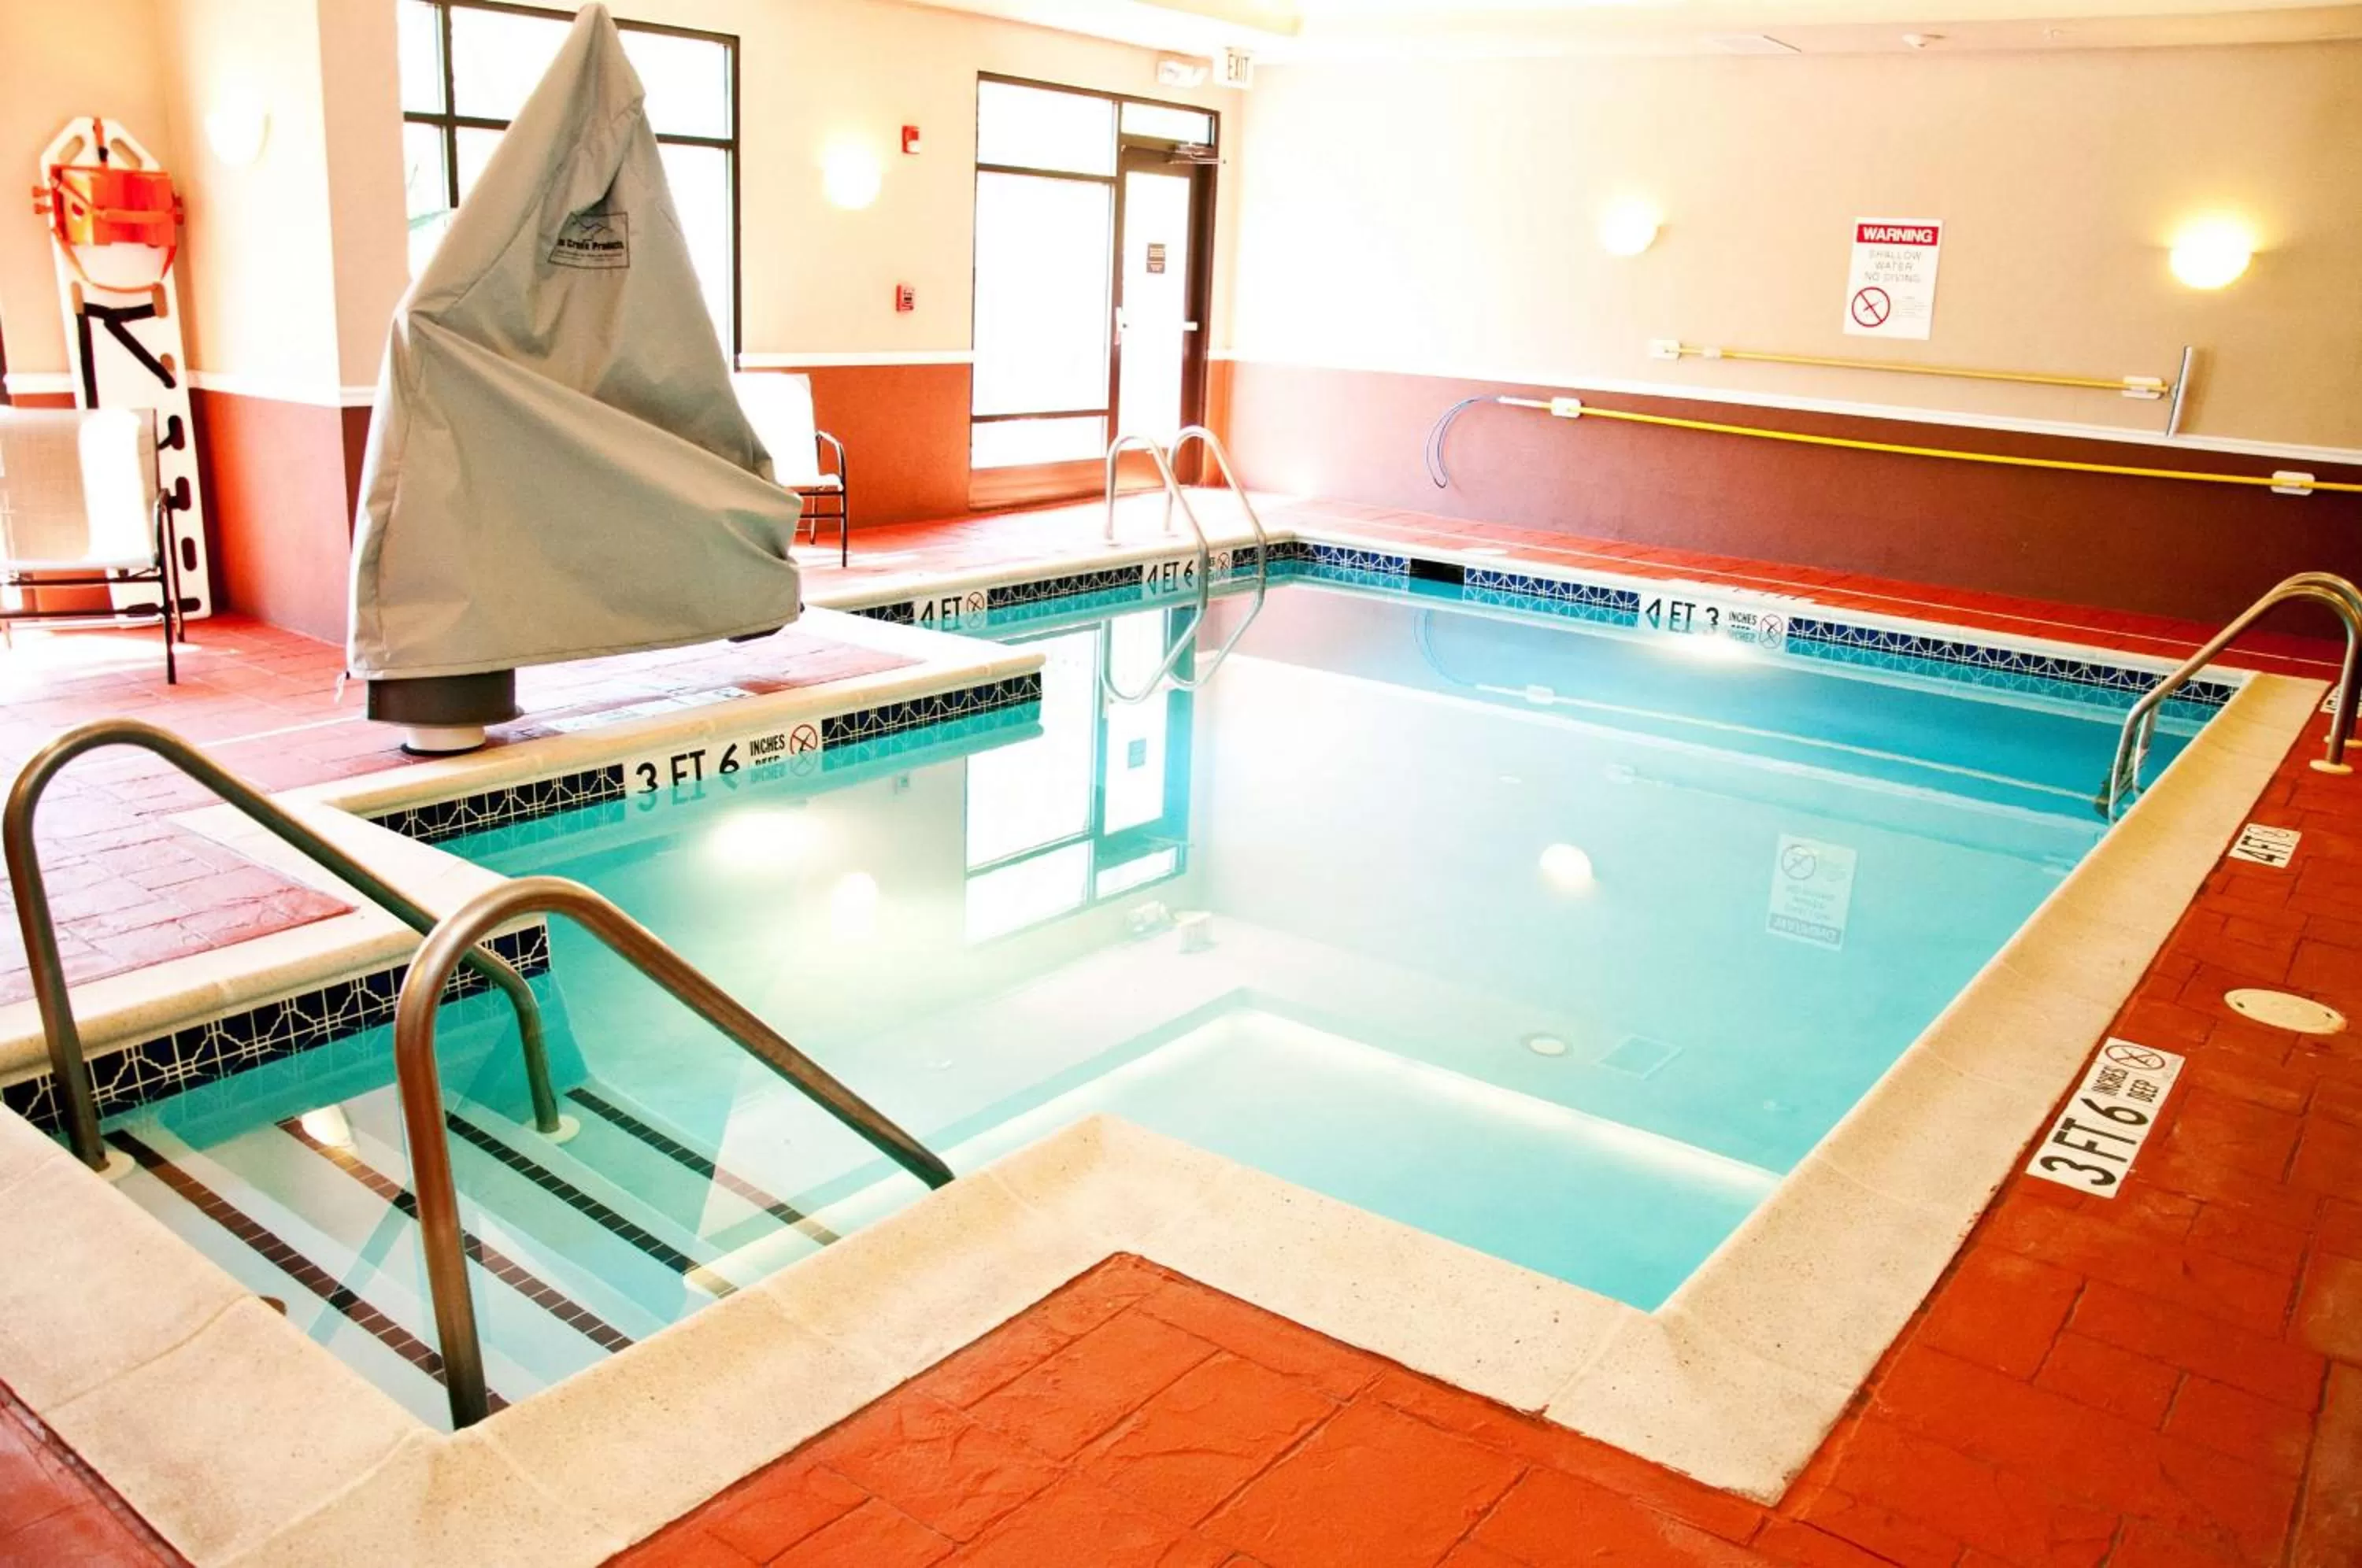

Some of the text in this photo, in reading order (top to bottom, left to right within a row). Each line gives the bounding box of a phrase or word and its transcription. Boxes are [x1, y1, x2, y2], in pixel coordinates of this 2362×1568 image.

[1227, 54, 1250, 83] EXIT
[1863, 226, 1933, 243] WARNING
[1868, 250, 1921, 262] SHALLOW
[1875, 261, 1914, 272] WATER
[1864, 271, 1880, 282] NO
[1183, 559, 1194, 577] 6
[942, 596, 963, 619] FT
[1728, 610, 1758, 626] INCHES
[749, 733, 786, 756] INCHES
[636, 742, 739, 794] 3 FT 6
[2091, 1065, 2129, 1096] INCHES
[2127, 1079, 2160, 1103] DEEP
[2039, 1155, 2117, 1186] 3
[2080, 1097, 2149, 1126] 6
